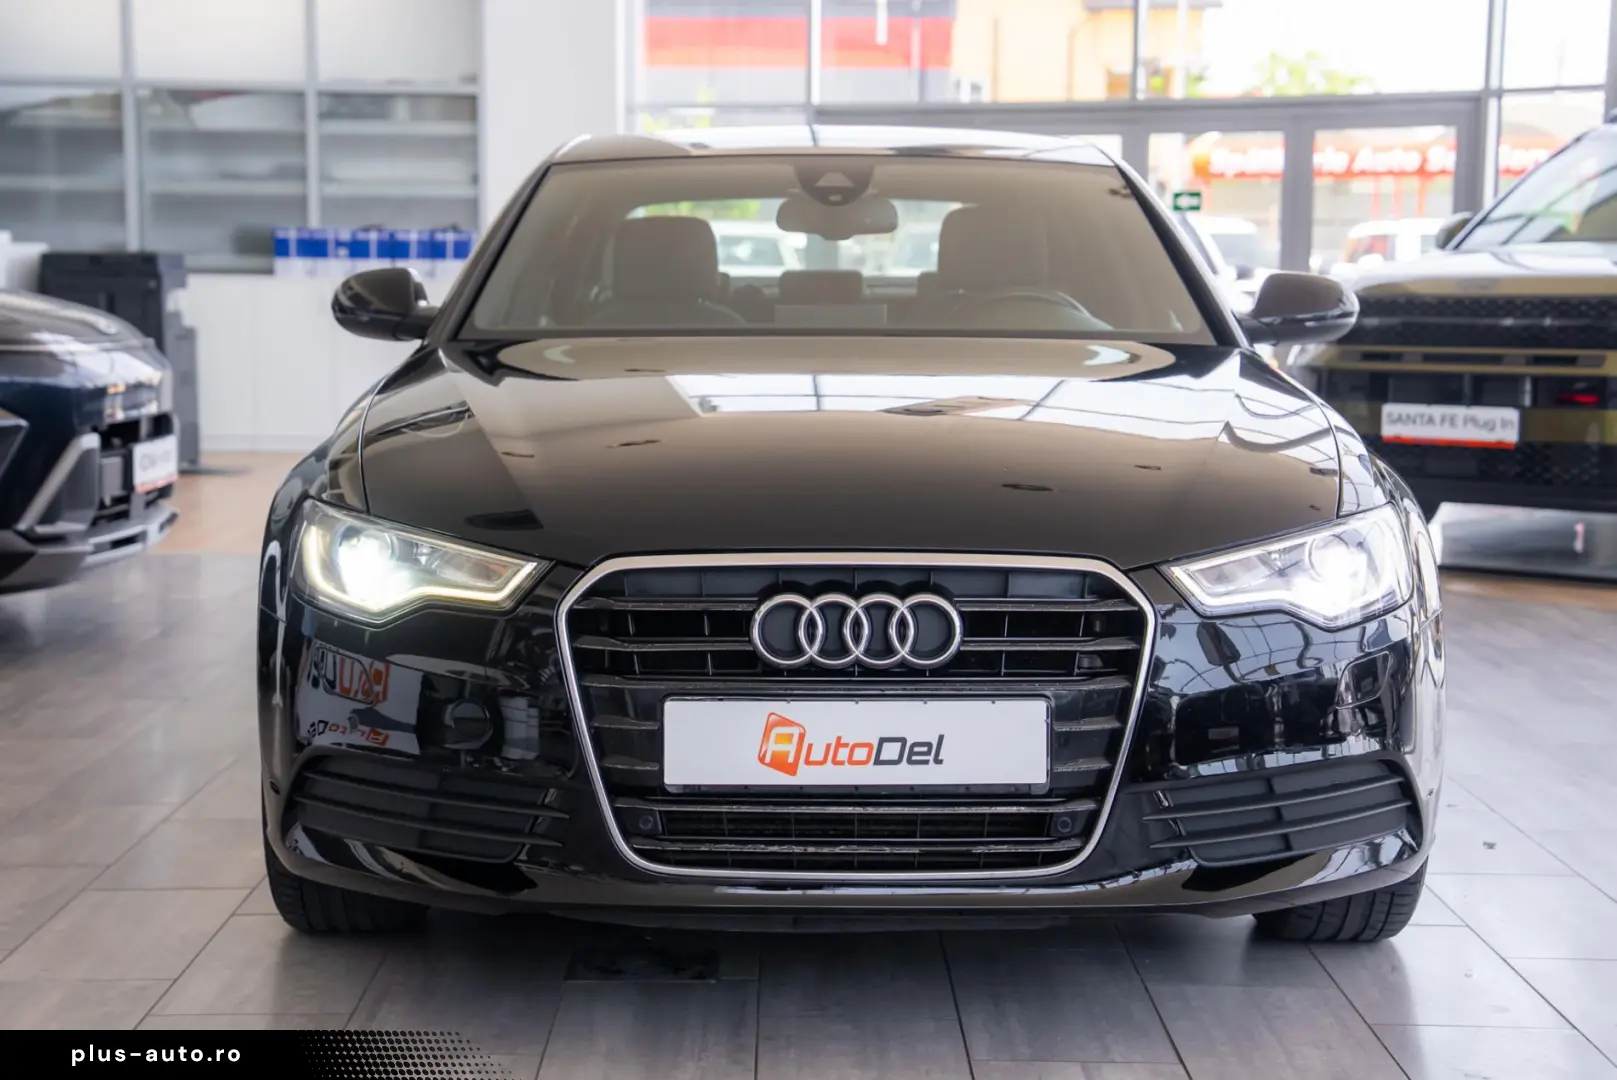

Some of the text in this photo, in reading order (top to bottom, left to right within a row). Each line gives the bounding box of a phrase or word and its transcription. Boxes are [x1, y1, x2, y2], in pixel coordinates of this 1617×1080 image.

[1386, 410, 1516, 434] SANTA FE Plug In
[758, 712, 945, 776] AutoDel
